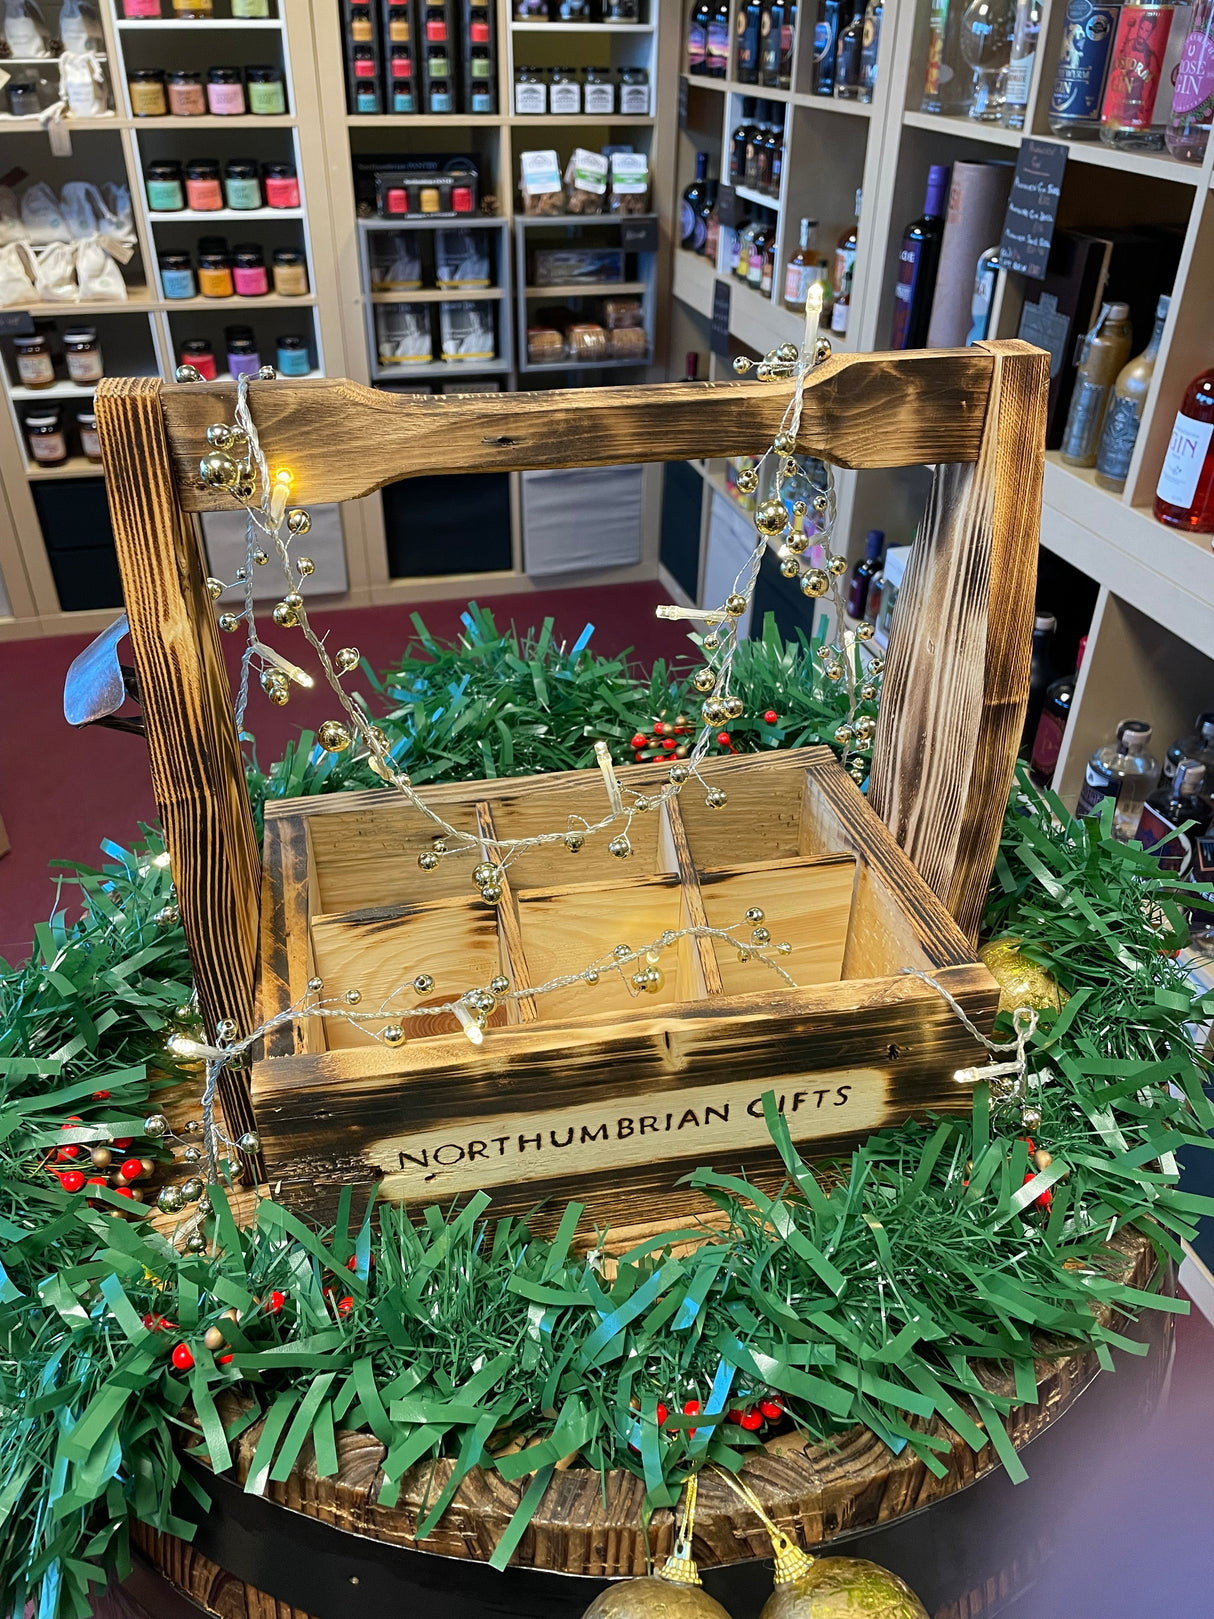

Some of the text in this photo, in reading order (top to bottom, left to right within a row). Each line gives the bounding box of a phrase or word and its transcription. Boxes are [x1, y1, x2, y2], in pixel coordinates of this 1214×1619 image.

[1175, 75, 1203, 95] GIN
[1170, 432, 1198, 458] GIN
[399, 1085, 853, 1171] NORTHUMBRIAN GIFTS
